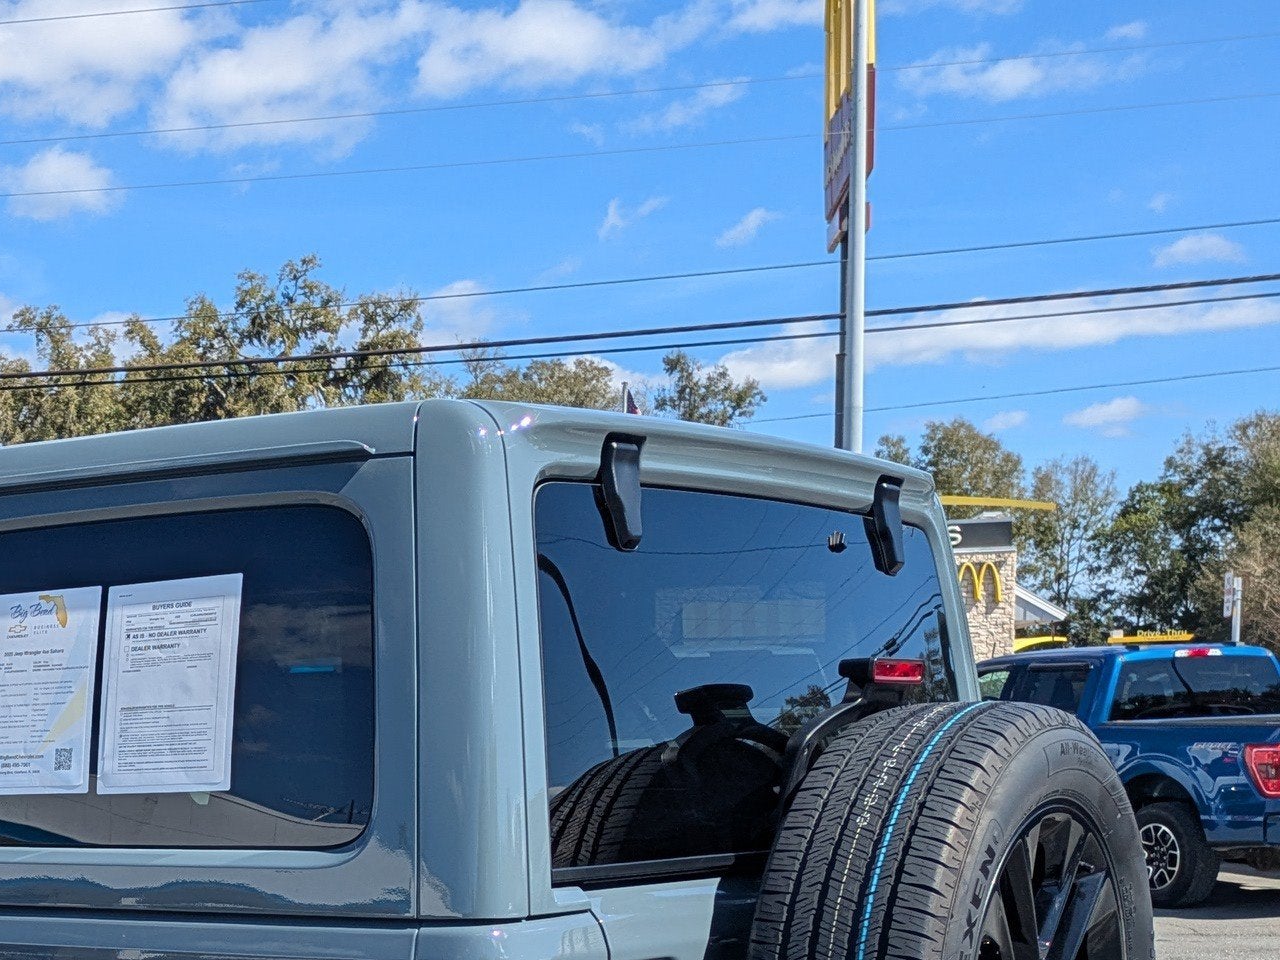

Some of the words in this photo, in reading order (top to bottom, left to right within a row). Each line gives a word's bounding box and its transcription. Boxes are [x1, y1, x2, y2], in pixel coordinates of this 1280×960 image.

[152, 602, 175, 611] BUYERS
[175, 601, 193, 609] GUIDE
[10, 604, 28, 624] Big
[30, 603, 57, 618] Bend
[156, 630, 178, 638] DEALER
[178, 628, 207, 636] WARRANTY
[152, 643, 181, 651] WARRANTY
